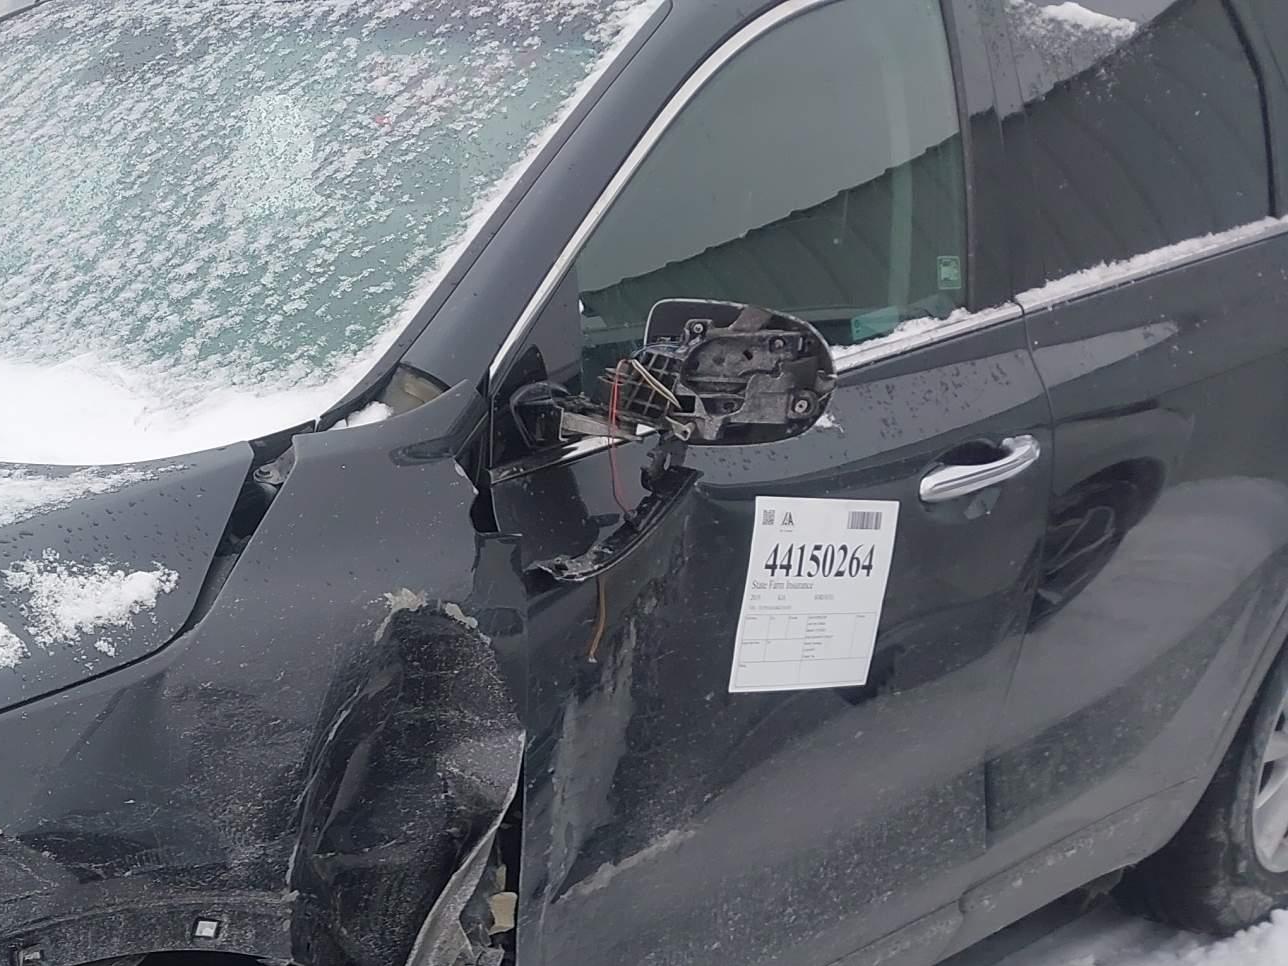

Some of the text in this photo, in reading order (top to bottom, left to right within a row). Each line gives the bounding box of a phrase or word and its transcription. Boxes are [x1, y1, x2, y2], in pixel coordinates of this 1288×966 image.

[764, 543, 875, 578] 44150264
[751, 579, 814, 590] State Farm Insurance
